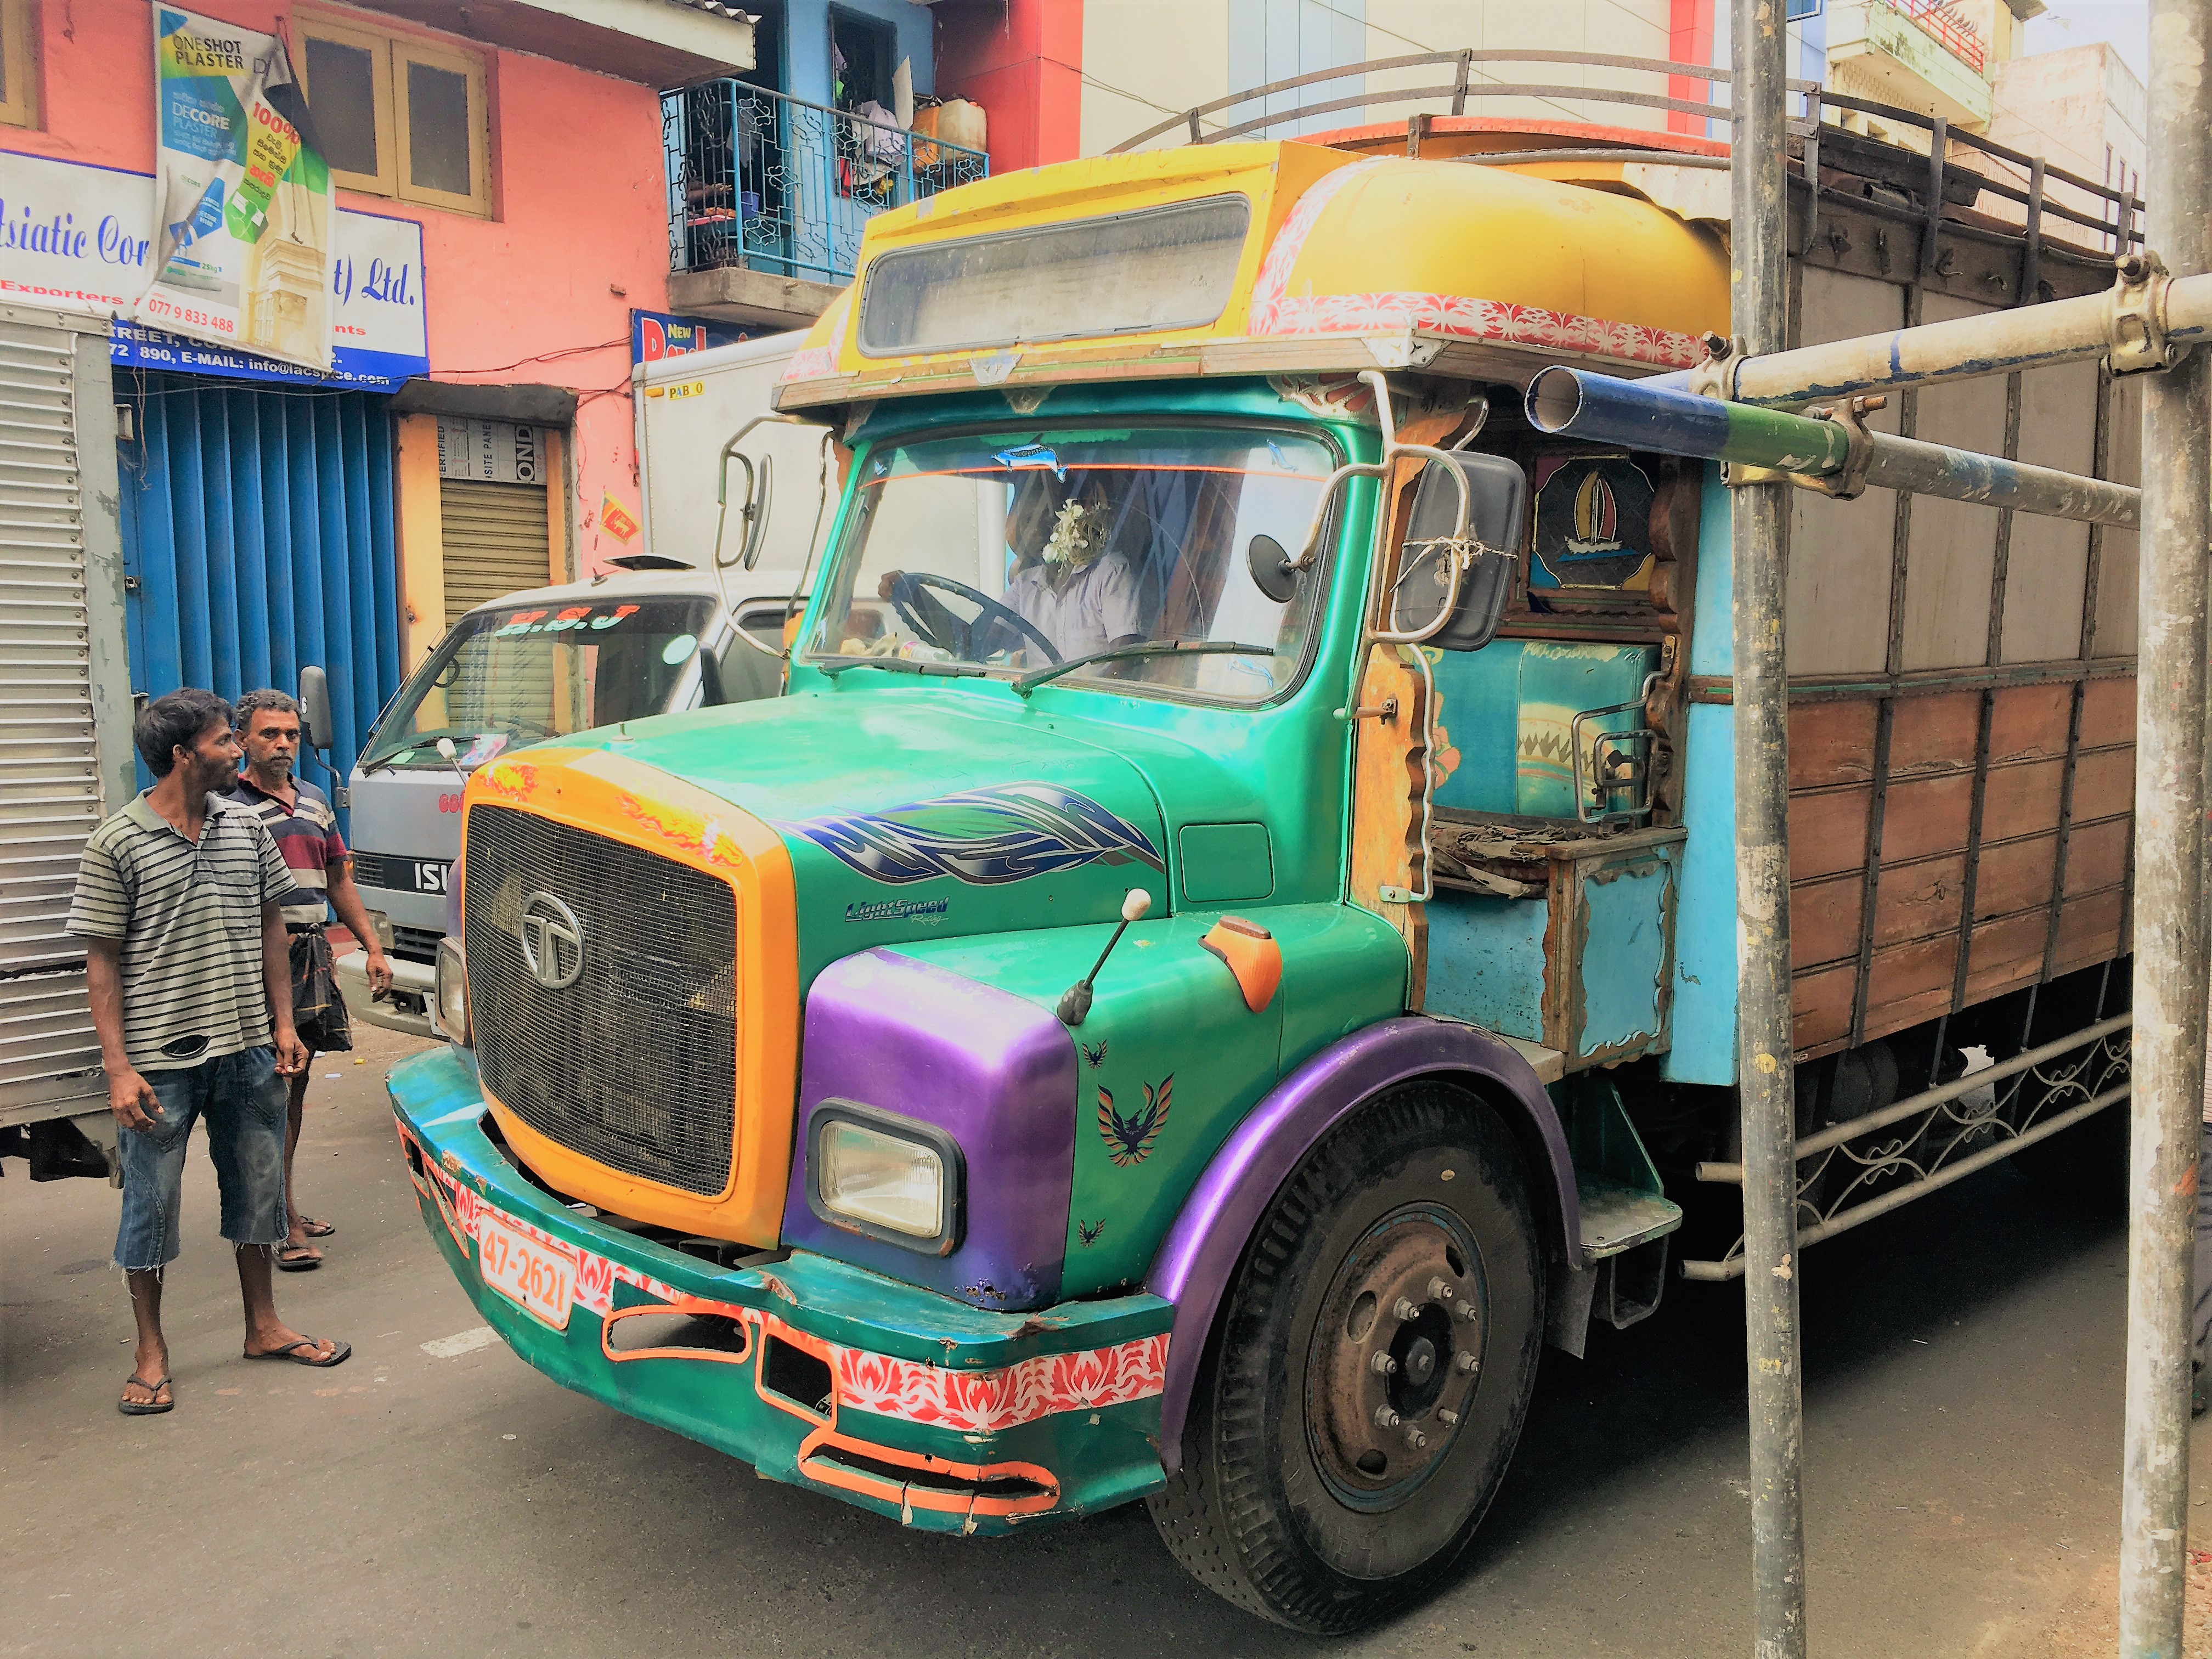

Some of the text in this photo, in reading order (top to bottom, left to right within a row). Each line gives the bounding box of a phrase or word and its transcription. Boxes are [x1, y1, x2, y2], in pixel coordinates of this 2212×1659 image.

[173, 34, 241, 54] ONESHOT
[176, 50, 244, 69] PLASTER
[172, 101, 230, 130] DECORE
[174, 116, 217, 138] PLASTER
[253, 101, 301, 145] 100%
[1, 280, 124, 305] Exporters
[361, 257, 414, 305] Ltd.
[149, 299, 171, 315] 077
[174, 306, 182, 318] 9
[185, 309, 207, 325] 833
[211, 317, 233, 332] 488
[140, 347, 176, 364] 890,
[182, 351, 244, 368] E-MAIL:
[482, 420, 492, 448] PANE
[438, 426, 446, 475] ERTIFIED
[845, 896, 950, 922] LightSpeed
[910, 914, 949, 926] Racing
[484, 1231, 566, 1312] 47-2621
